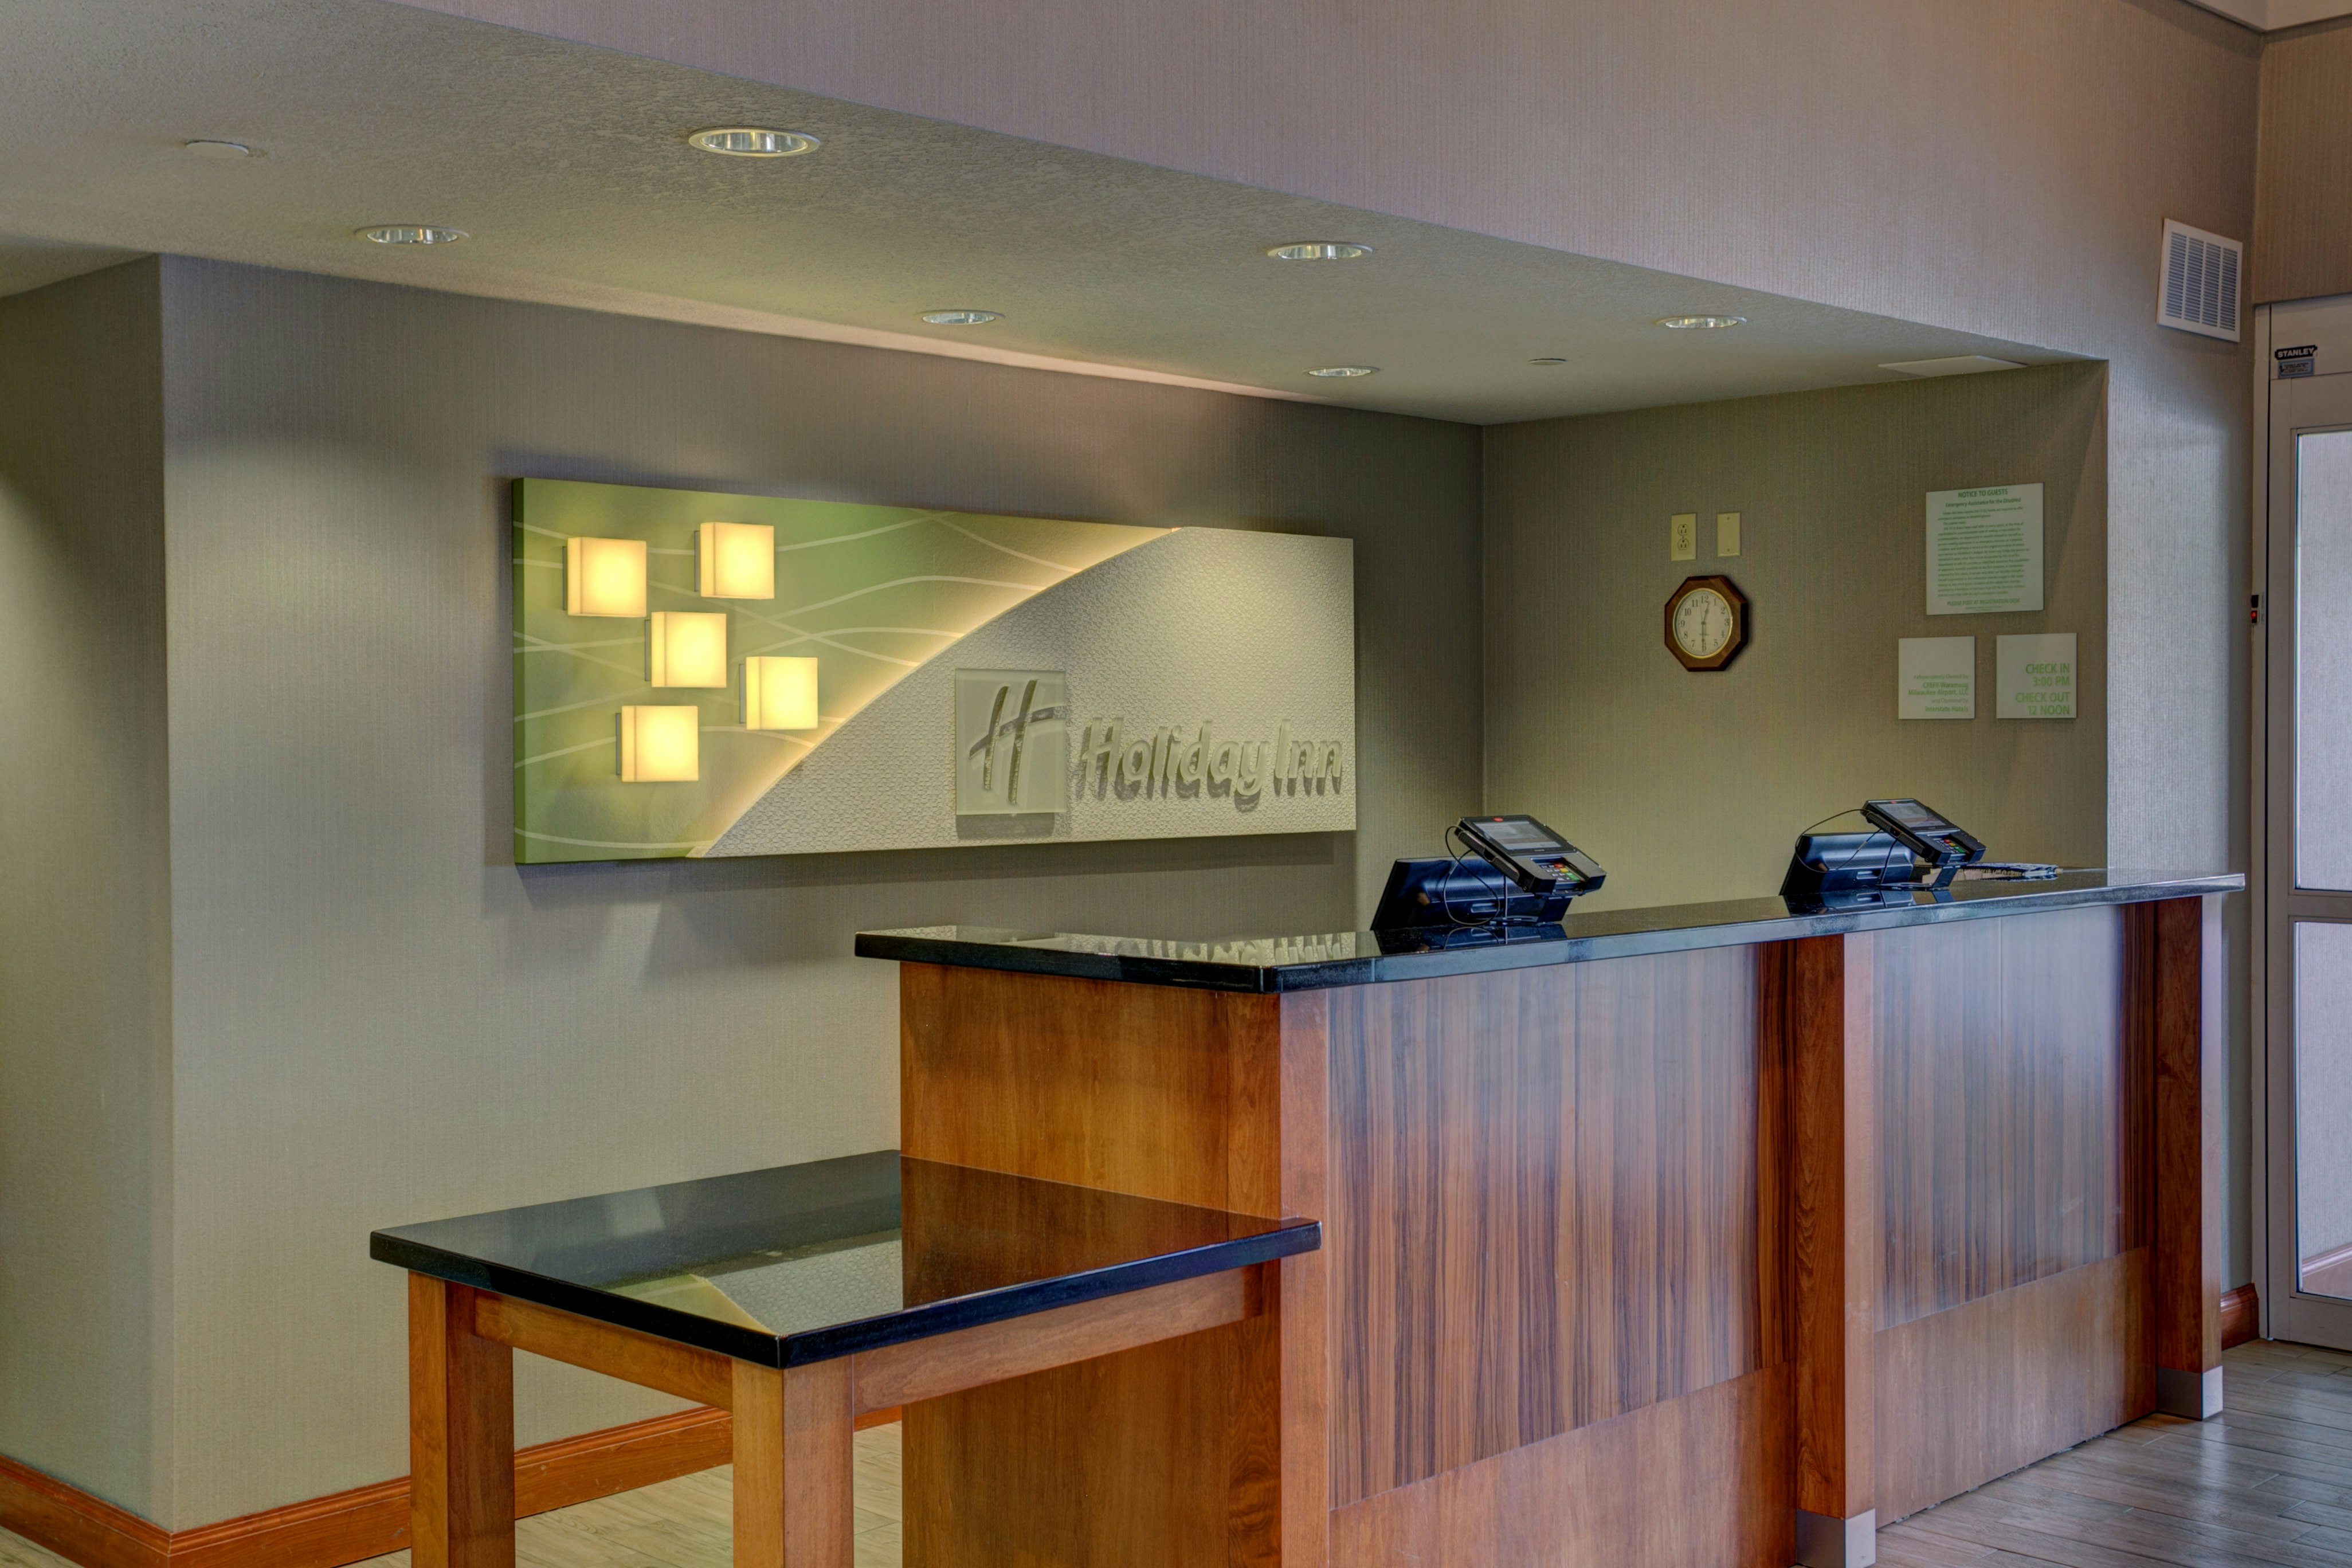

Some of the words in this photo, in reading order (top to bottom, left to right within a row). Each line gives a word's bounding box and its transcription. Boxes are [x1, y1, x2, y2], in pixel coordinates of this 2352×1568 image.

[2277, 347, 2314, 358] STANLEY
[1692, 599, 1699, 607] 11
[1701, 595, 1709, 603] 12
[1684, 608, 1691, 616] 10
[1680, 620, 1685, 628] 9
[1724, 618, 1729, 626] 3
[1684, 631, 1688, 639] 8
[1720, 630, 1725, 638] 4
[1691, 640, 1695, 648] 7
[1714, 639, 1718, 647] 5
[2026, 664, 2057, 675] CHECK
[2060, 663, 2070, 674] IN
[2033, 676, 2052, 687] 3:00
[2055, 676, 2070, 686] PM
[2015, 692, 2047, 703] CHECK
[2049, 692, 2071, 703] OUT
[2028, 705, 2037, 715] 12
[2041, 704, 2070, 715] NOON
[1081, 717, 1268, 796] Holiday
[1275, 719, 1343, 778] Inn
